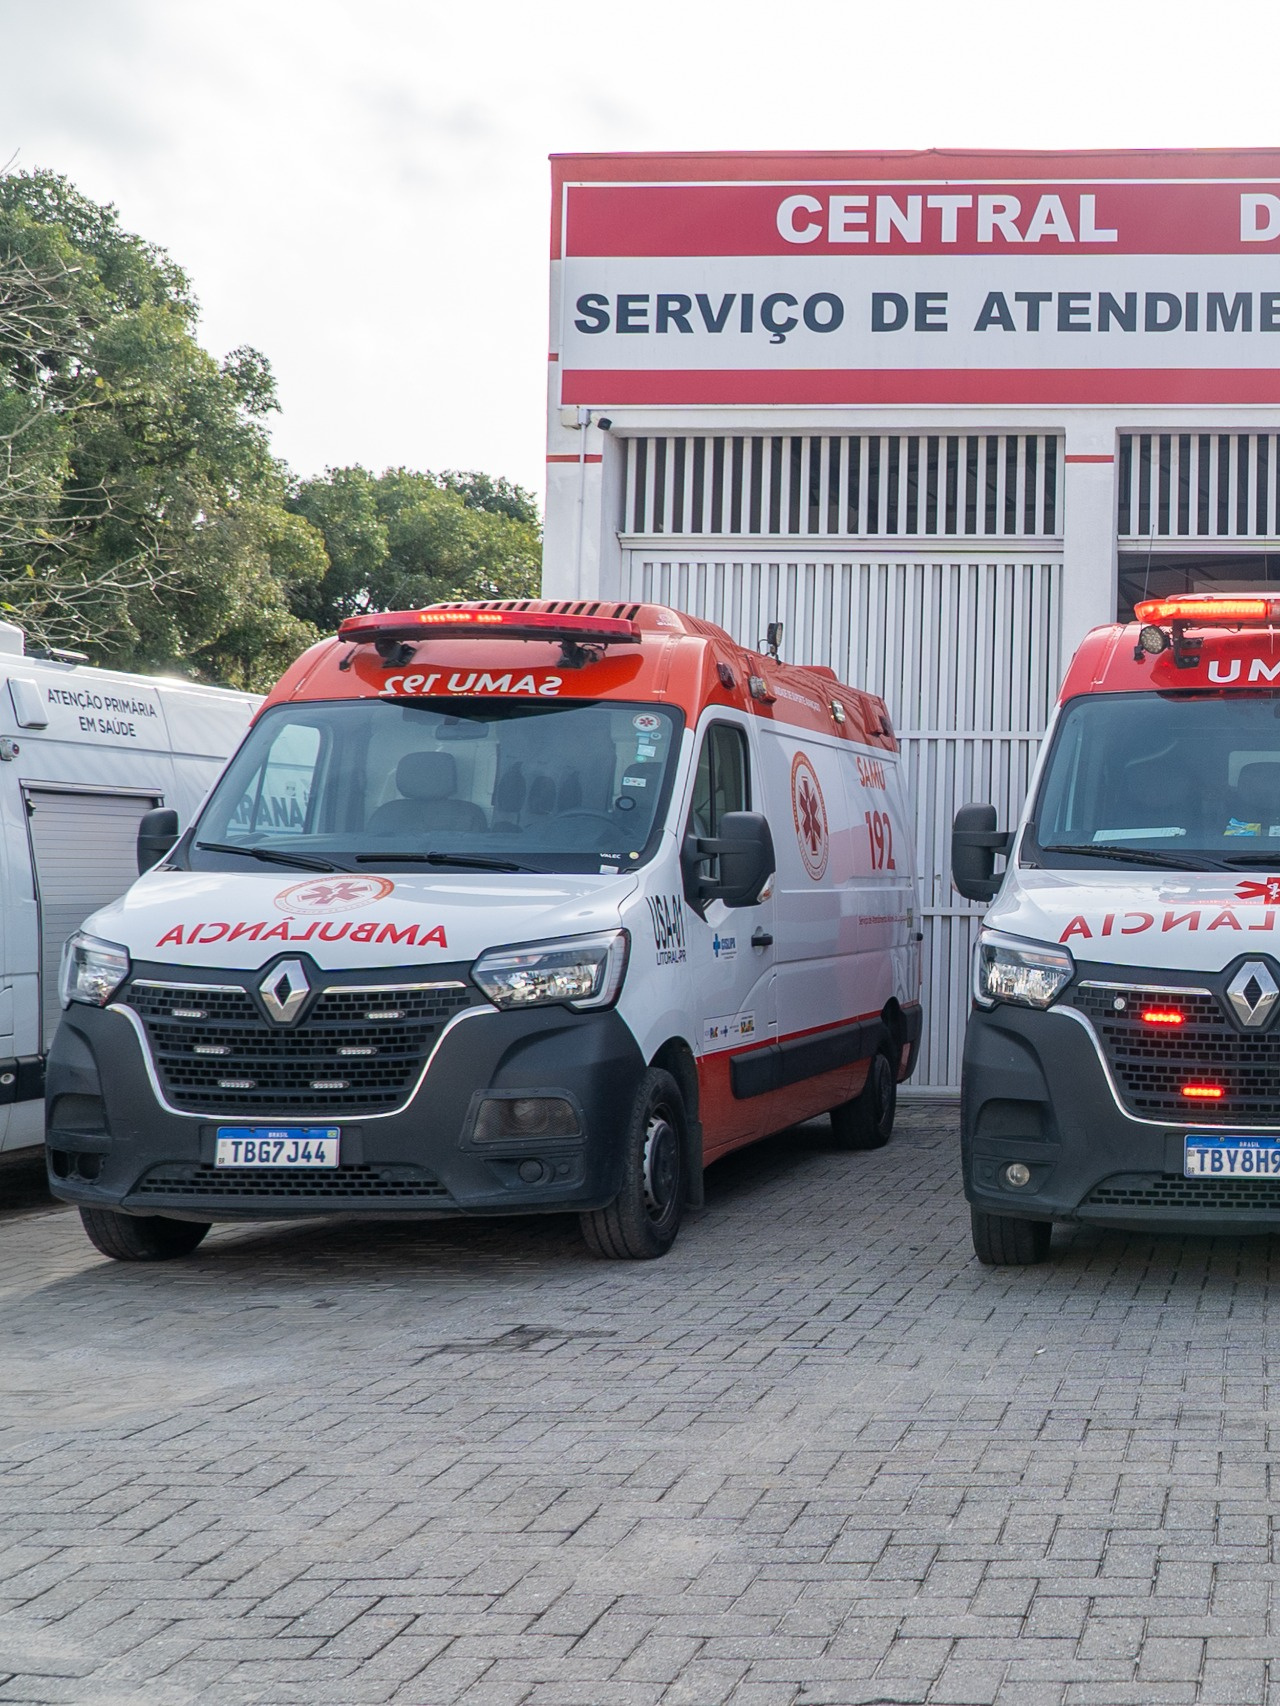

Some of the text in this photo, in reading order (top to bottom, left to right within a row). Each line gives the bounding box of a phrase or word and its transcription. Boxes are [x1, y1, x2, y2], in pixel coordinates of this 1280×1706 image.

[776, 193, 1118, 244] CENTRAL
[574, 291, 844, 344] SERVIÇO
[871, 291, 949, 333] DE
[48, 688, 158, 718] ATENÇÃO PRIMÁRIA
[78, 715, 137, 737] EM SAÚDE
[856, 756, 886, 791] SAMU
[865, 810, 896, 870] 192
[645, 894, 686, 950] USA-01
[231, 1141, 326, 1163] TBG7J44
